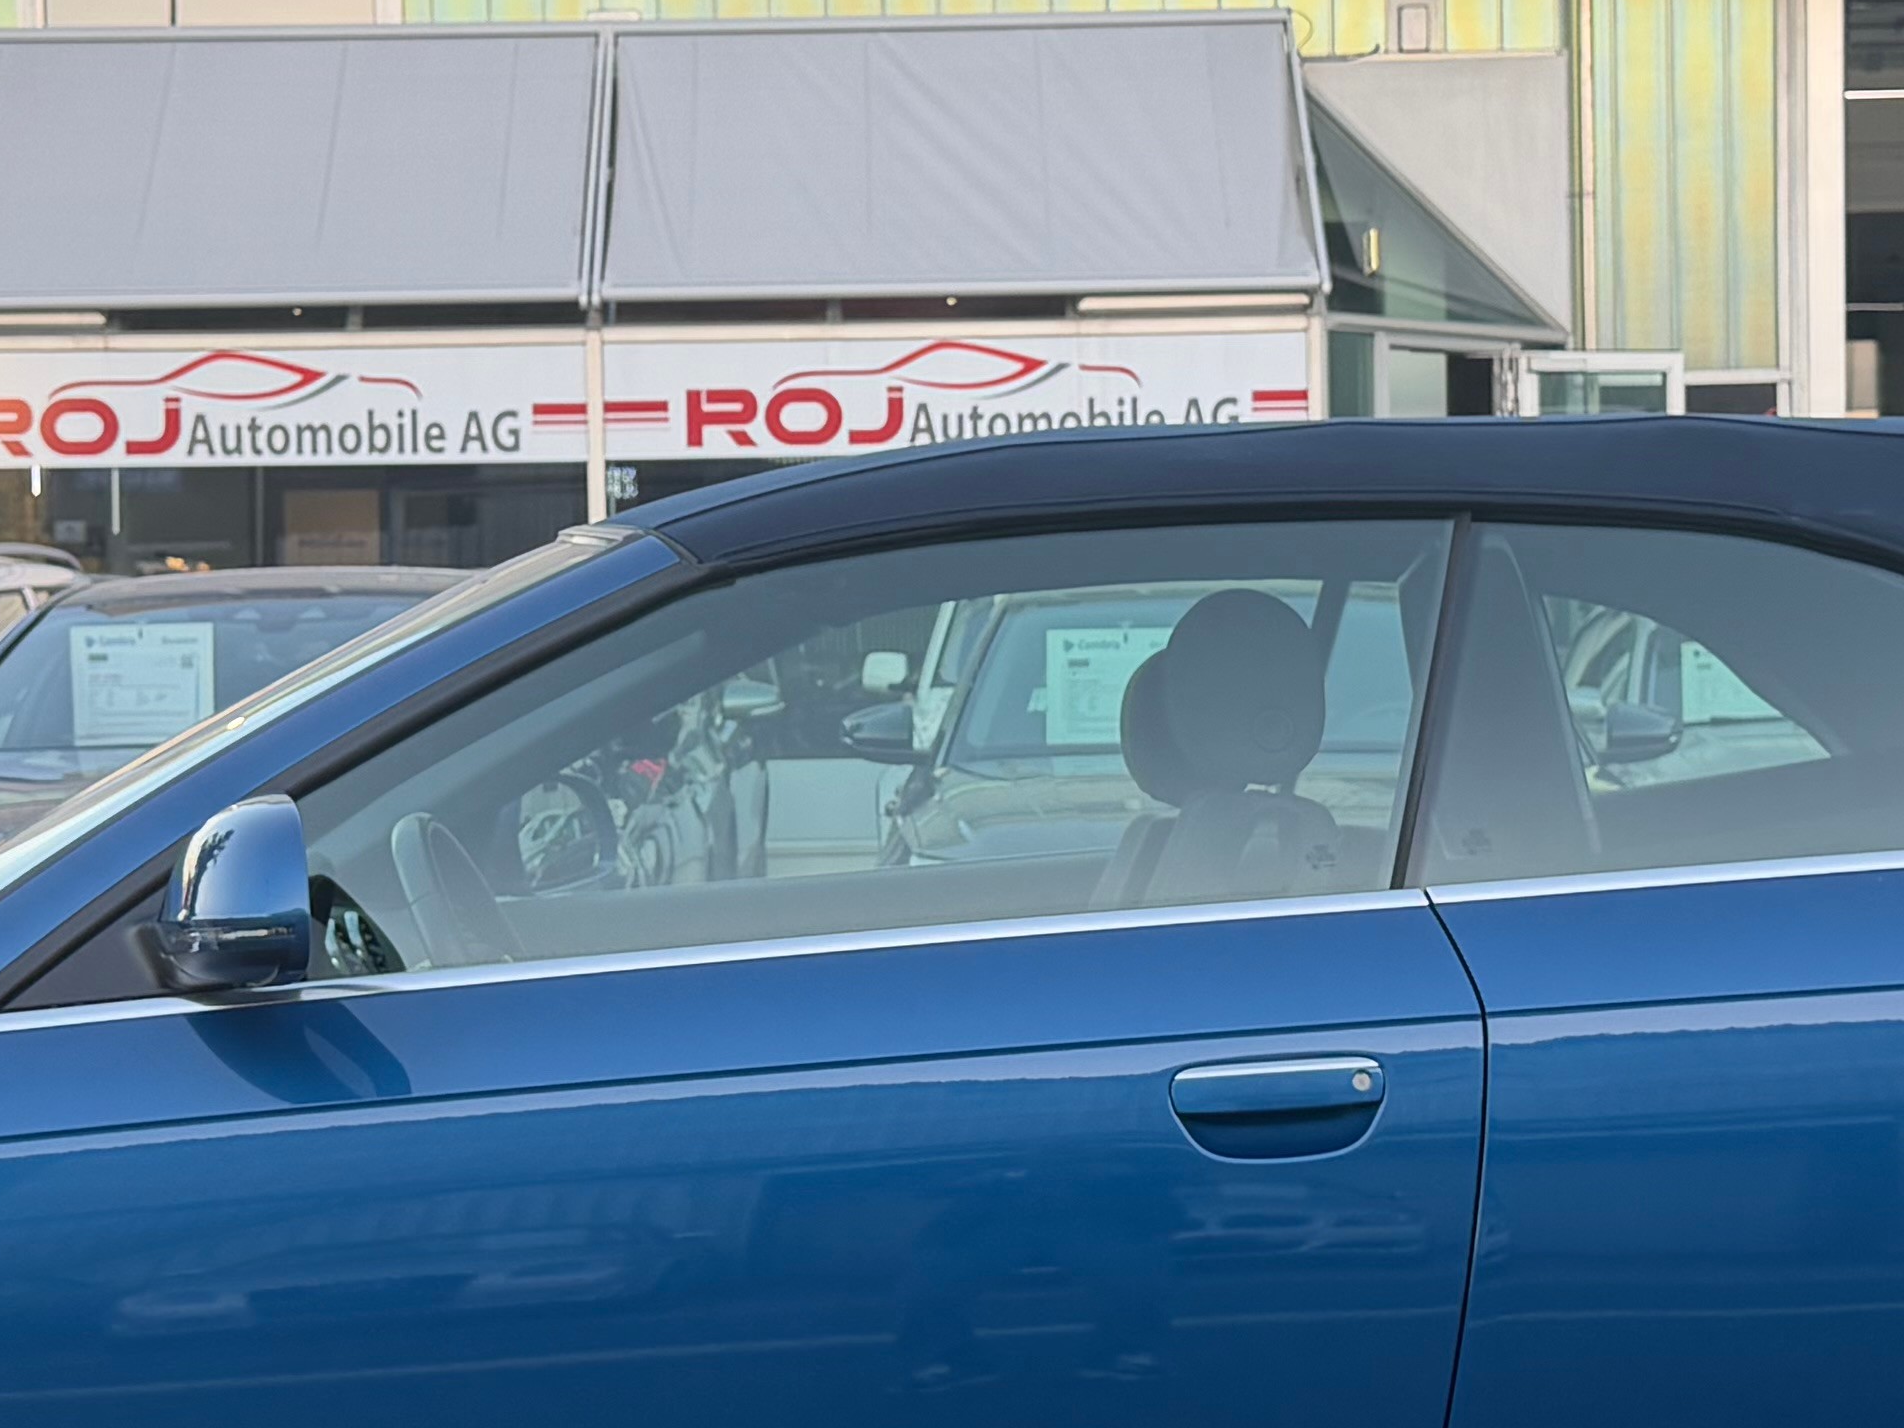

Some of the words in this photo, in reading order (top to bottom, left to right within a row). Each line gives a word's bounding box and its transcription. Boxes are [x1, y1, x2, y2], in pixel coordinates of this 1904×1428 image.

[187, 408, 448, 456] Automobile
[459, 410, 521, 454] AG
[685, 385, 905, 448] ROJ
[1182, 396, 1239, 426] AG
